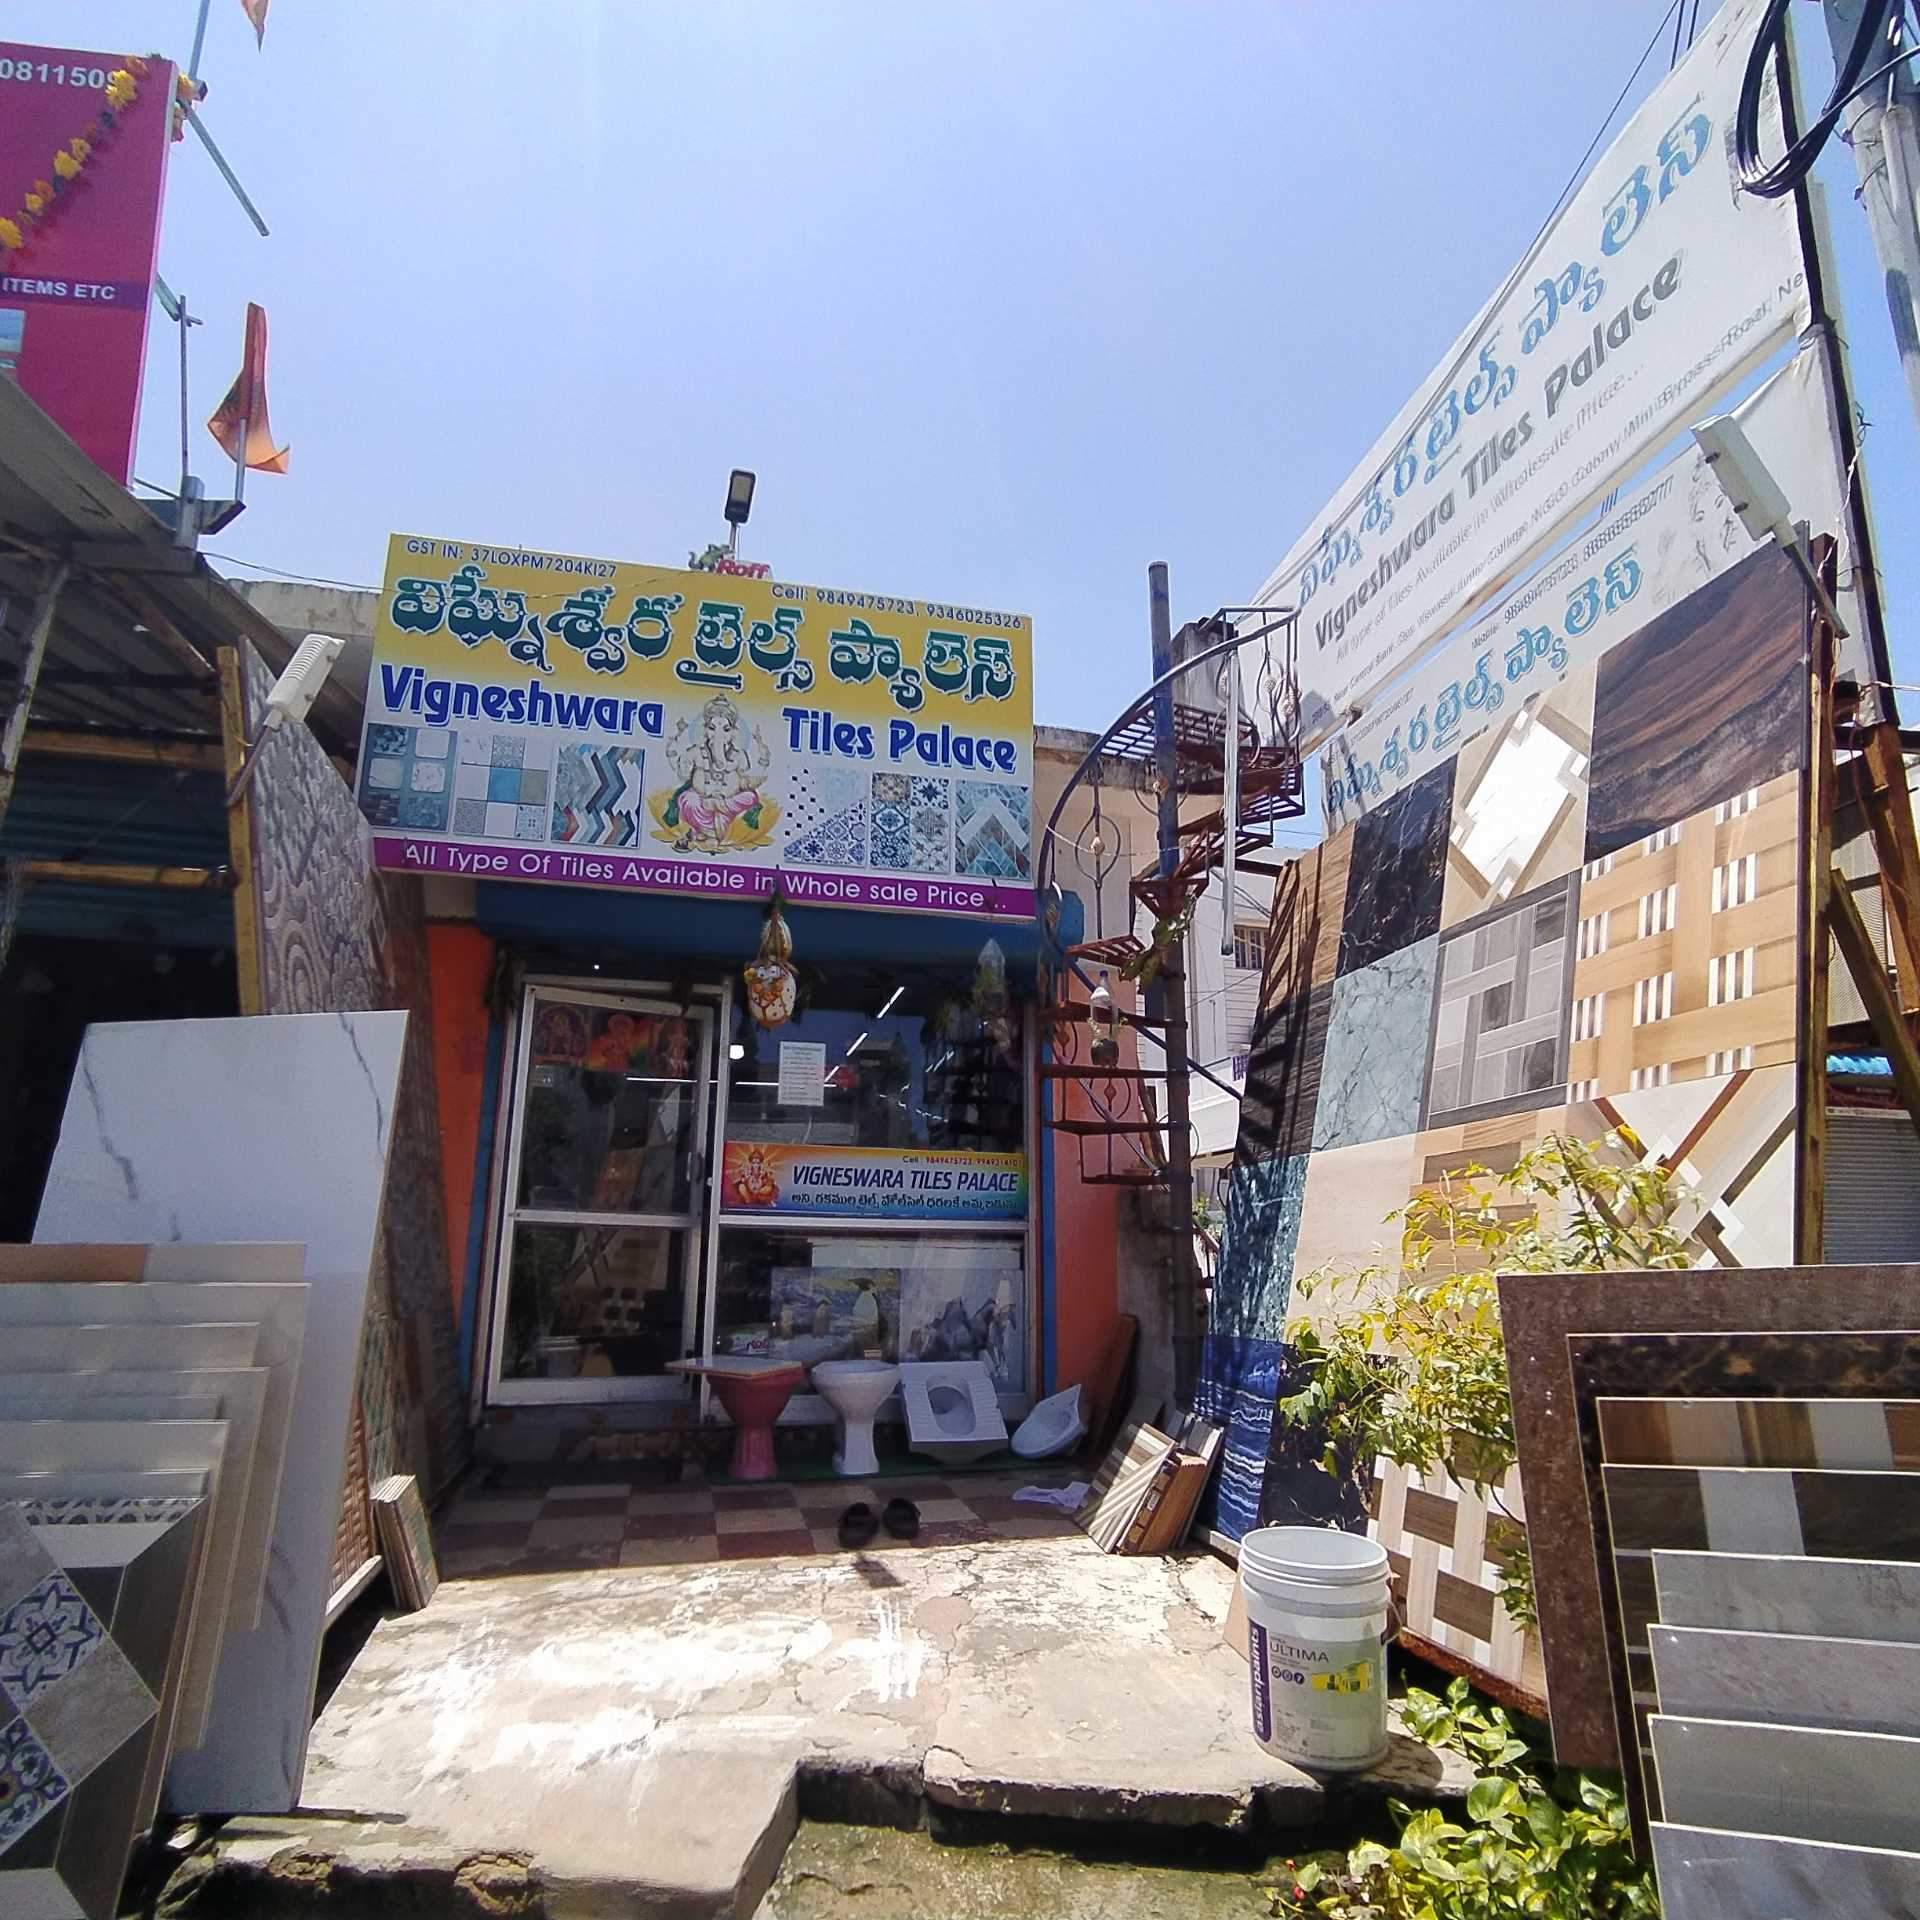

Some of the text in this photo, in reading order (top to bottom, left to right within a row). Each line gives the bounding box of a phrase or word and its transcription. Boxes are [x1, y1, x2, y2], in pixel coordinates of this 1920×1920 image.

[2, 277, 116, 300] ITEMS ETC
[1315, 489, 1455, 650] Vigneshwara
[1461, 411, 1533, 499] Tiles
[1545, 256, 1682, 418] Palace
[407, 539, 436, 555] GST
[442, 544, 463, 559] IN:
[716, 559, 771, 580] Roff
[673, 600, 815, 692] టైల్స్
[381, 664, 1017, 774] Vigneshwara Tiles Palace
[406, 844, 985, 907] All Type Of Tiles Available in Whole sale Price
[791, 1165, 1019, 1192] VIGNESWARA TILES PALACE
[1270, 1641, 1329, 1662] ULTIMA
[1249, 1627, 1266, 1734] asianpaints
